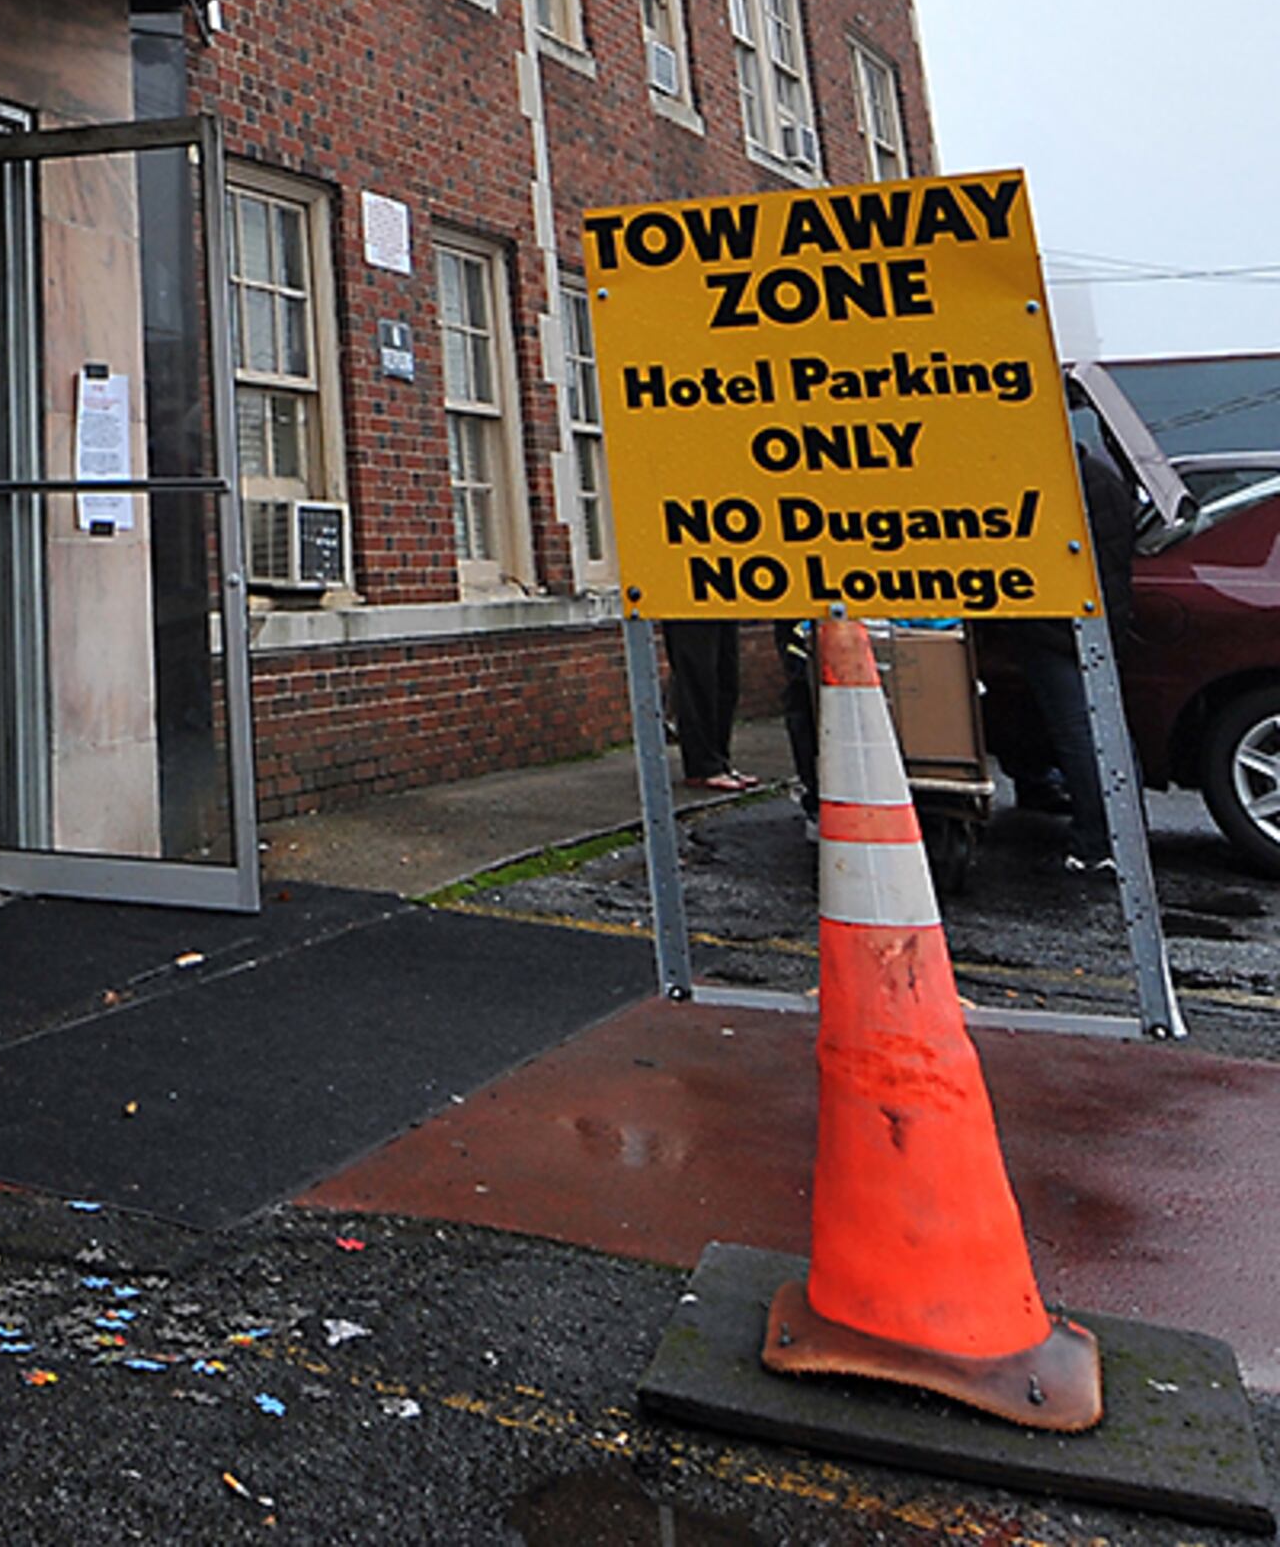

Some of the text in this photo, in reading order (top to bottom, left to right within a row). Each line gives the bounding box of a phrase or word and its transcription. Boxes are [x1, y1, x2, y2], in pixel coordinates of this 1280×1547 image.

[585, 180, 1023, 270] TOW AWAY
[707, 259, 934, 328] ZONE
[623, 352, 1032, 409] Hotel Parking
[751, 422, 922, 471] ONLY
[664, 490, 1039, 551] NO Dugans/
[689, 555, 1036, 610] NO Lounge
